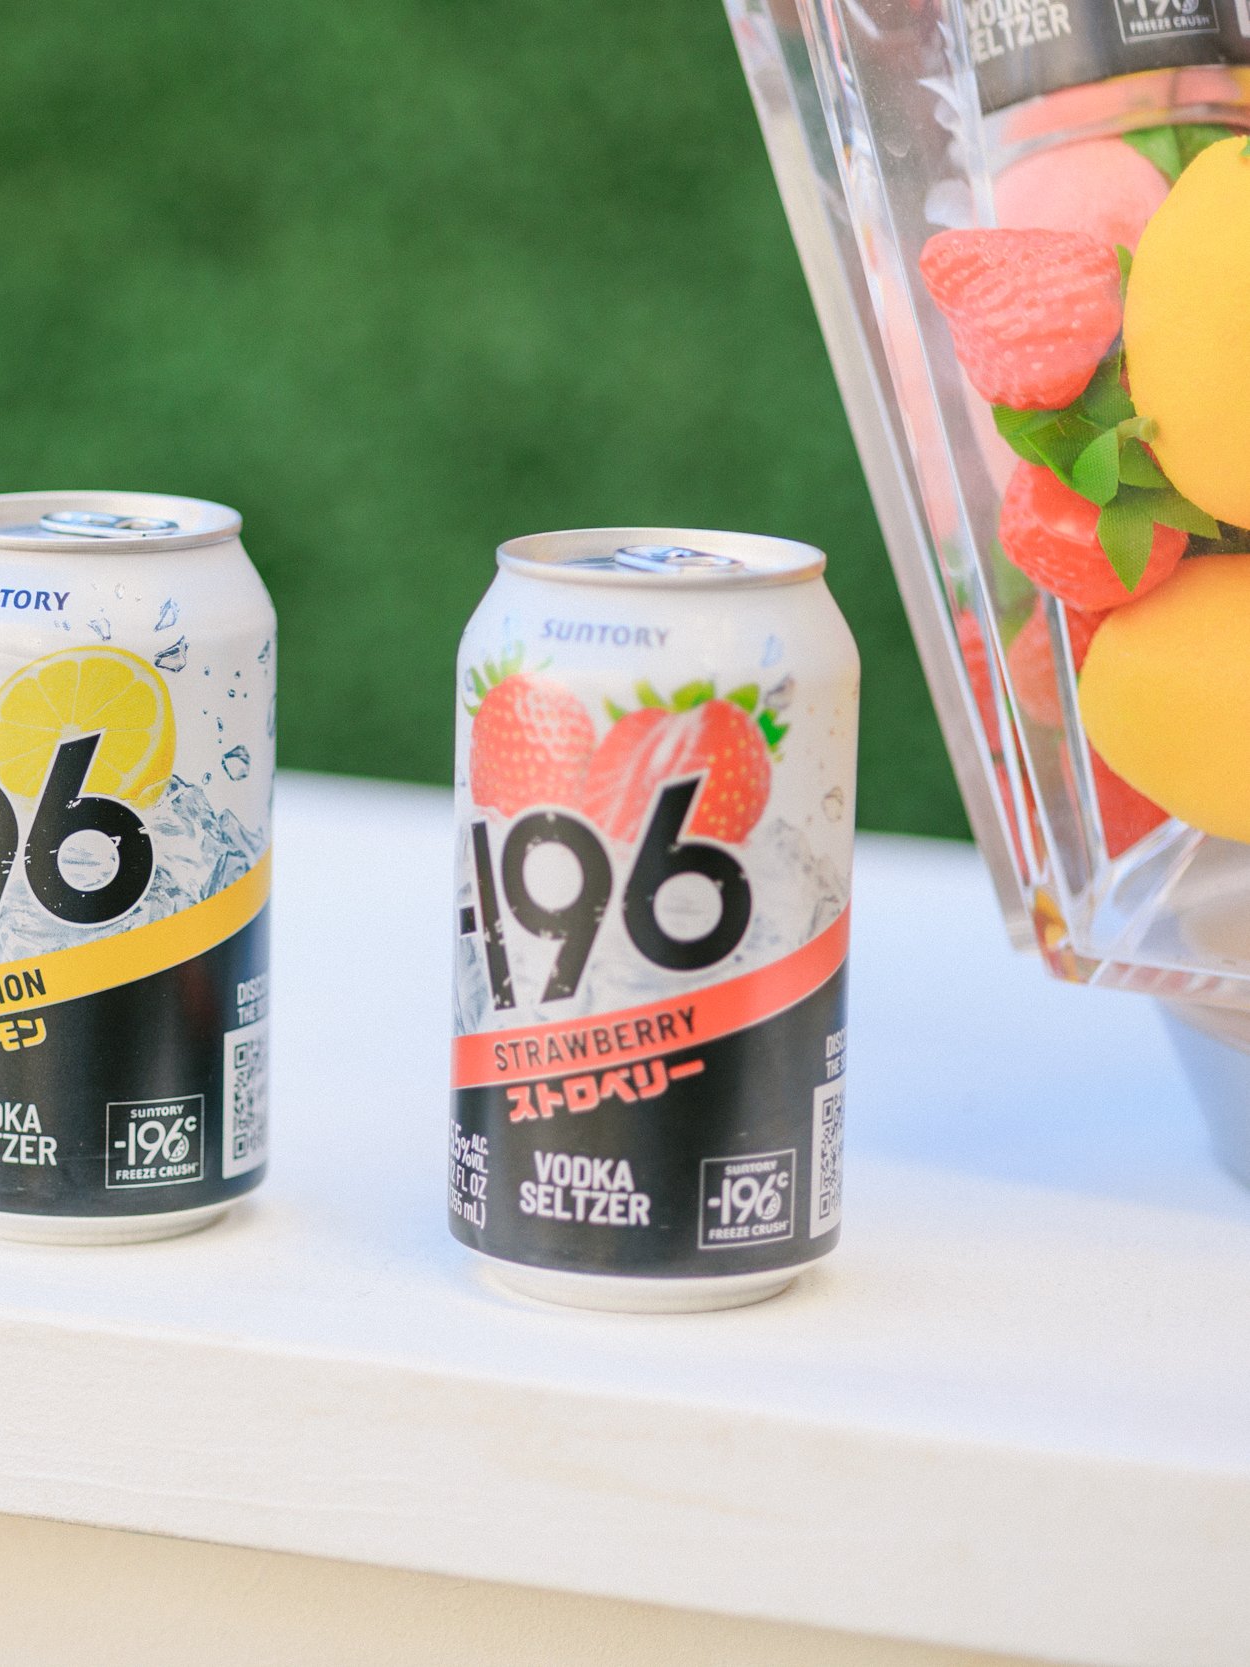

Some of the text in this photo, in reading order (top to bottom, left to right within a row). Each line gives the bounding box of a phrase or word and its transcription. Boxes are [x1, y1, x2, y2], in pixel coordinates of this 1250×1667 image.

[970, 3, 1071, 62] ELTZER
[459, 776, 752, 1010] -196
[494, 1005, 698, 1072] STRAWBERRY
[507, 1058, 706, 1123] ストロベリー
[116, 1168, 157, 1181] FREEZE
[456, 1165, 468, 1193] FL
[470, 1173, 487, 1201] OZ
[534, 1150, 636, 1193] VODKA
[519, 1180, 650, 1227] SELTZER
[708, 1226, 750, 1240] FREEZE
